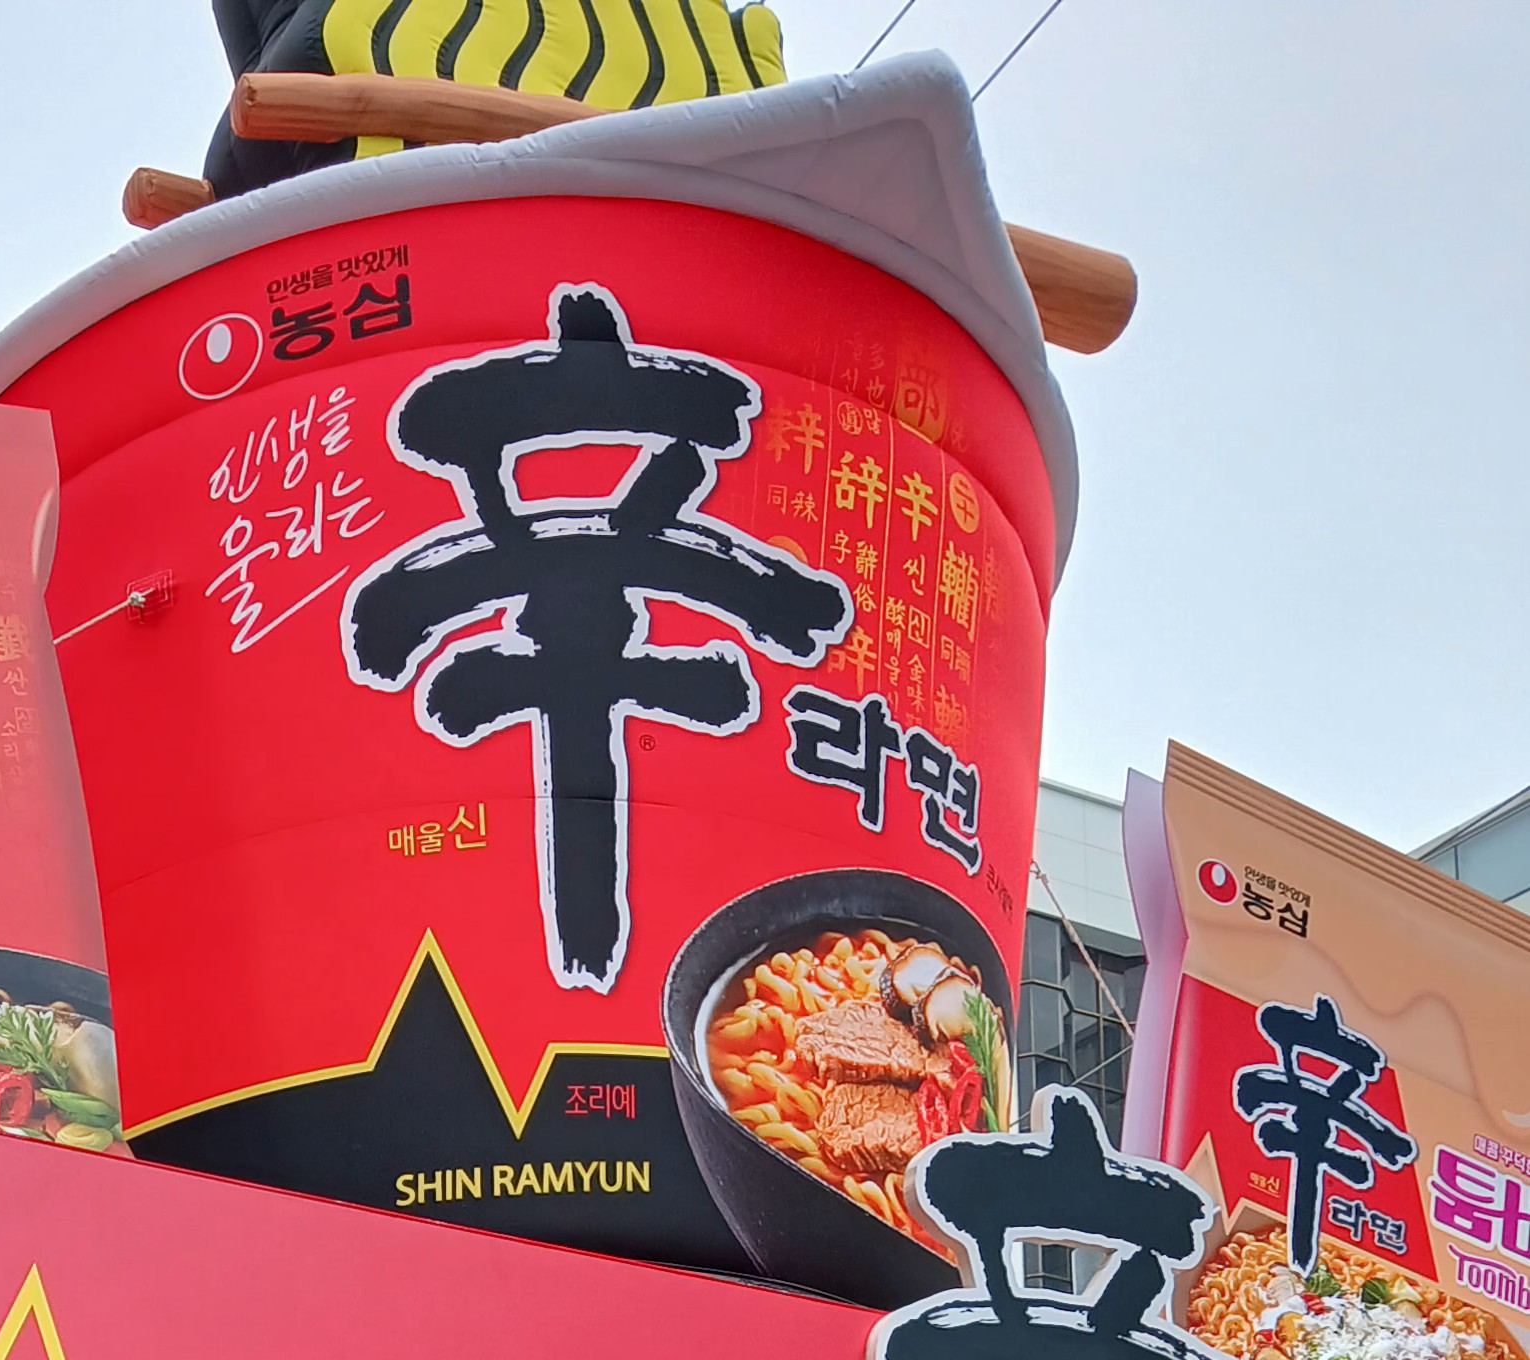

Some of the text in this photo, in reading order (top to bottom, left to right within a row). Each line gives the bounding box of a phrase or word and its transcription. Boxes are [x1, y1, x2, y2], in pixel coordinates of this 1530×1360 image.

[267, 244, 408, 303] 인생을 맛있게
[268, 274, 413, 361] 농심
[209, 386, 356, 504] 인생을
[205, 471, 385, 653] 울리는
[343, 280, 983, 996] 辛 라면
[387, 805, 488, 858] 매울신
[1242, 882, 1308, 938] 농심
[1278, 882, 1311, 907] 맛있게
[563, 1084, 637, 1120] 조리예
[1233, 994, 1418, 1277] 辛 라면
[395, 1160, 652, 1207] SHIN RAMYUN
